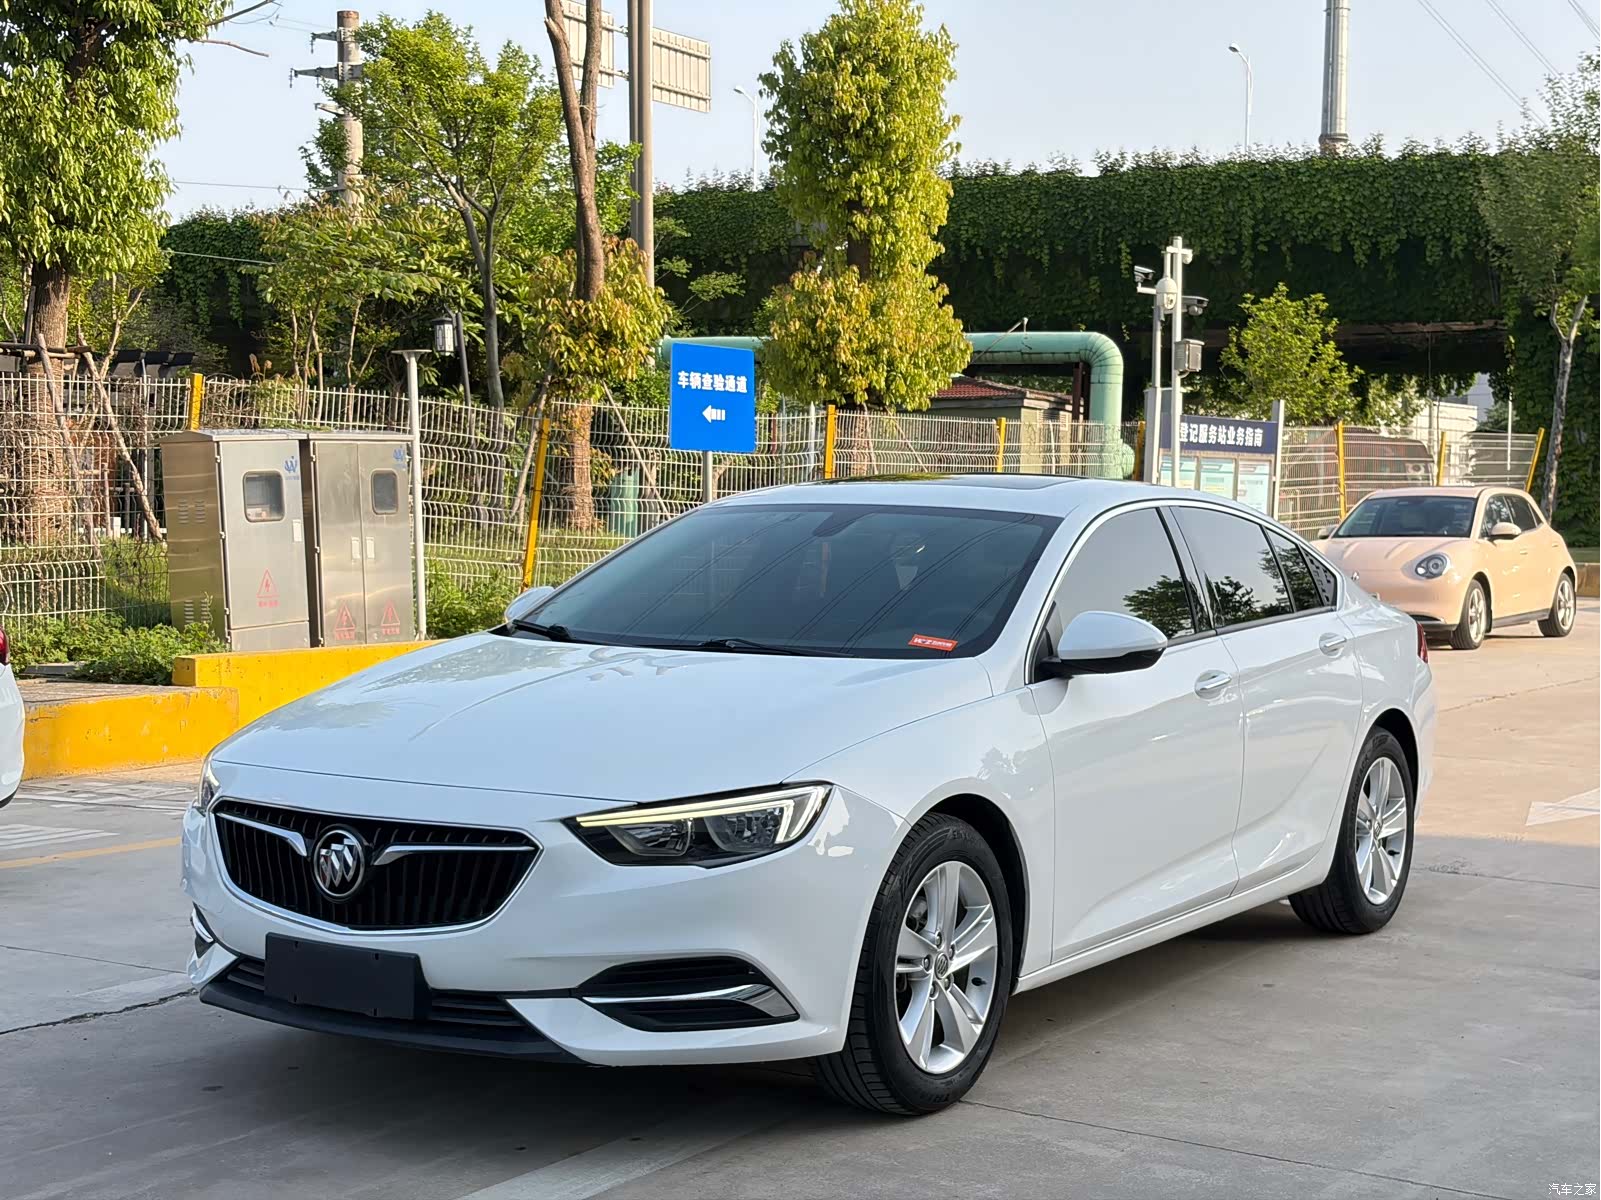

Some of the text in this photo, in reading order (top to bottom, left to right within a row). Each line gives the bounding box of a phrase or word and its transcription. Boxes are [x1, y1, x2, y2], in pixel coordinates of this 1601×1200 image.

[677, 370, 748, 394] 车辆查验通道
[1179, 422, 1264, 447] 登记服务站业务指南
